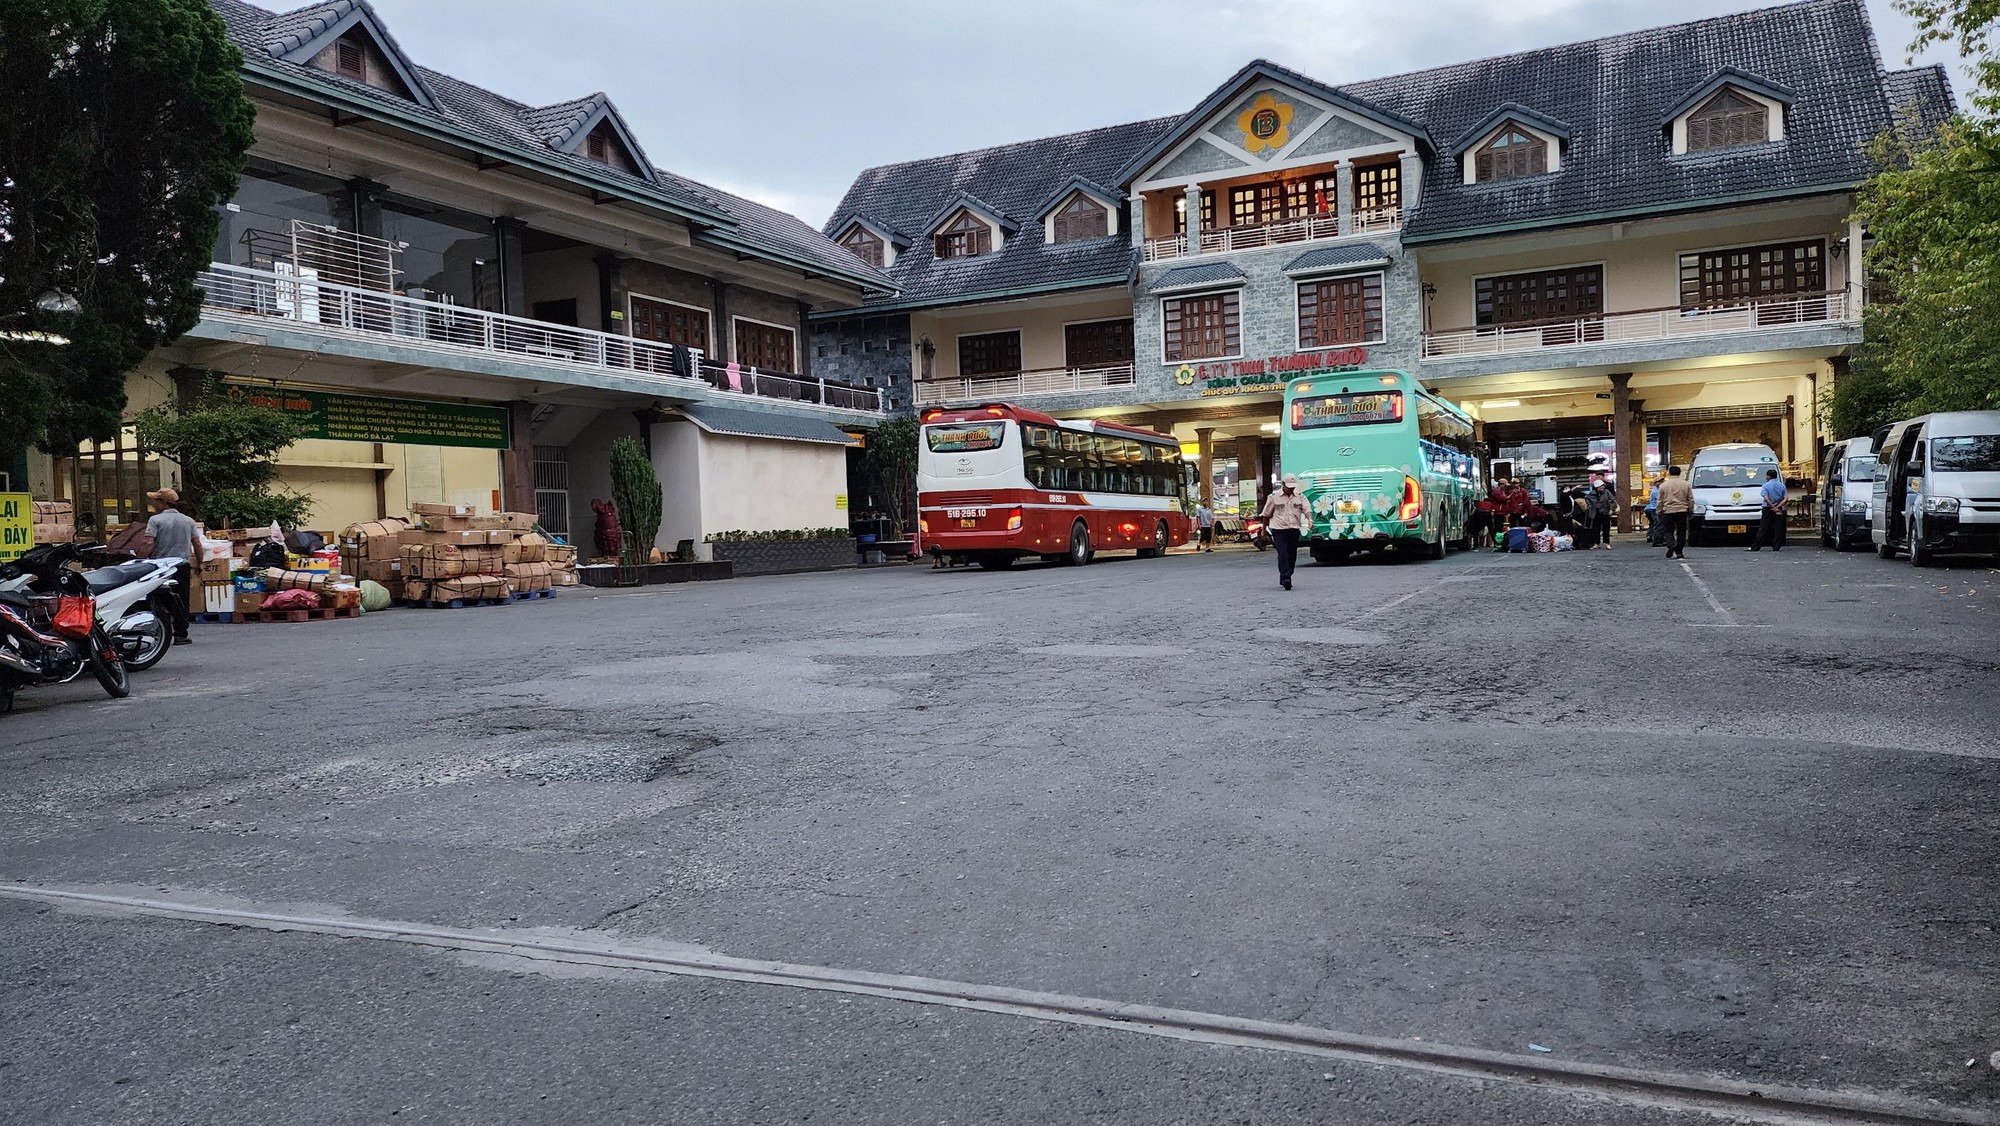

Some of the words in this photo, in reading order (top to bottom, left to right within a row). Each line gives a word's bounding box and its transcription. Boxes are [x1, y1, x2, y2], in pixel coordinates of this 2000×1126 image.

[1232, 358, 1265, 377] TNHH
[1269, 352, 1323, 373] THÀNH
[1326, 346, 1369, 368] BƯỞI
[1207, 376, 1237, 389] KÍNH
[1240, 372, 1276, 386] CHÀO
[1200, 388, 1221, 397] CHÚC
[1223, 386, 1240, 395] QUÝ
[1242, 384, 1270, 393] KHÁCH
[1315, 404, 1349, 416] THÀNH
[354, 431, 369, 439] PHỐ
[0, 501, 18, 521] ẠI
[4, 524, 27, 545] ĐÂY
